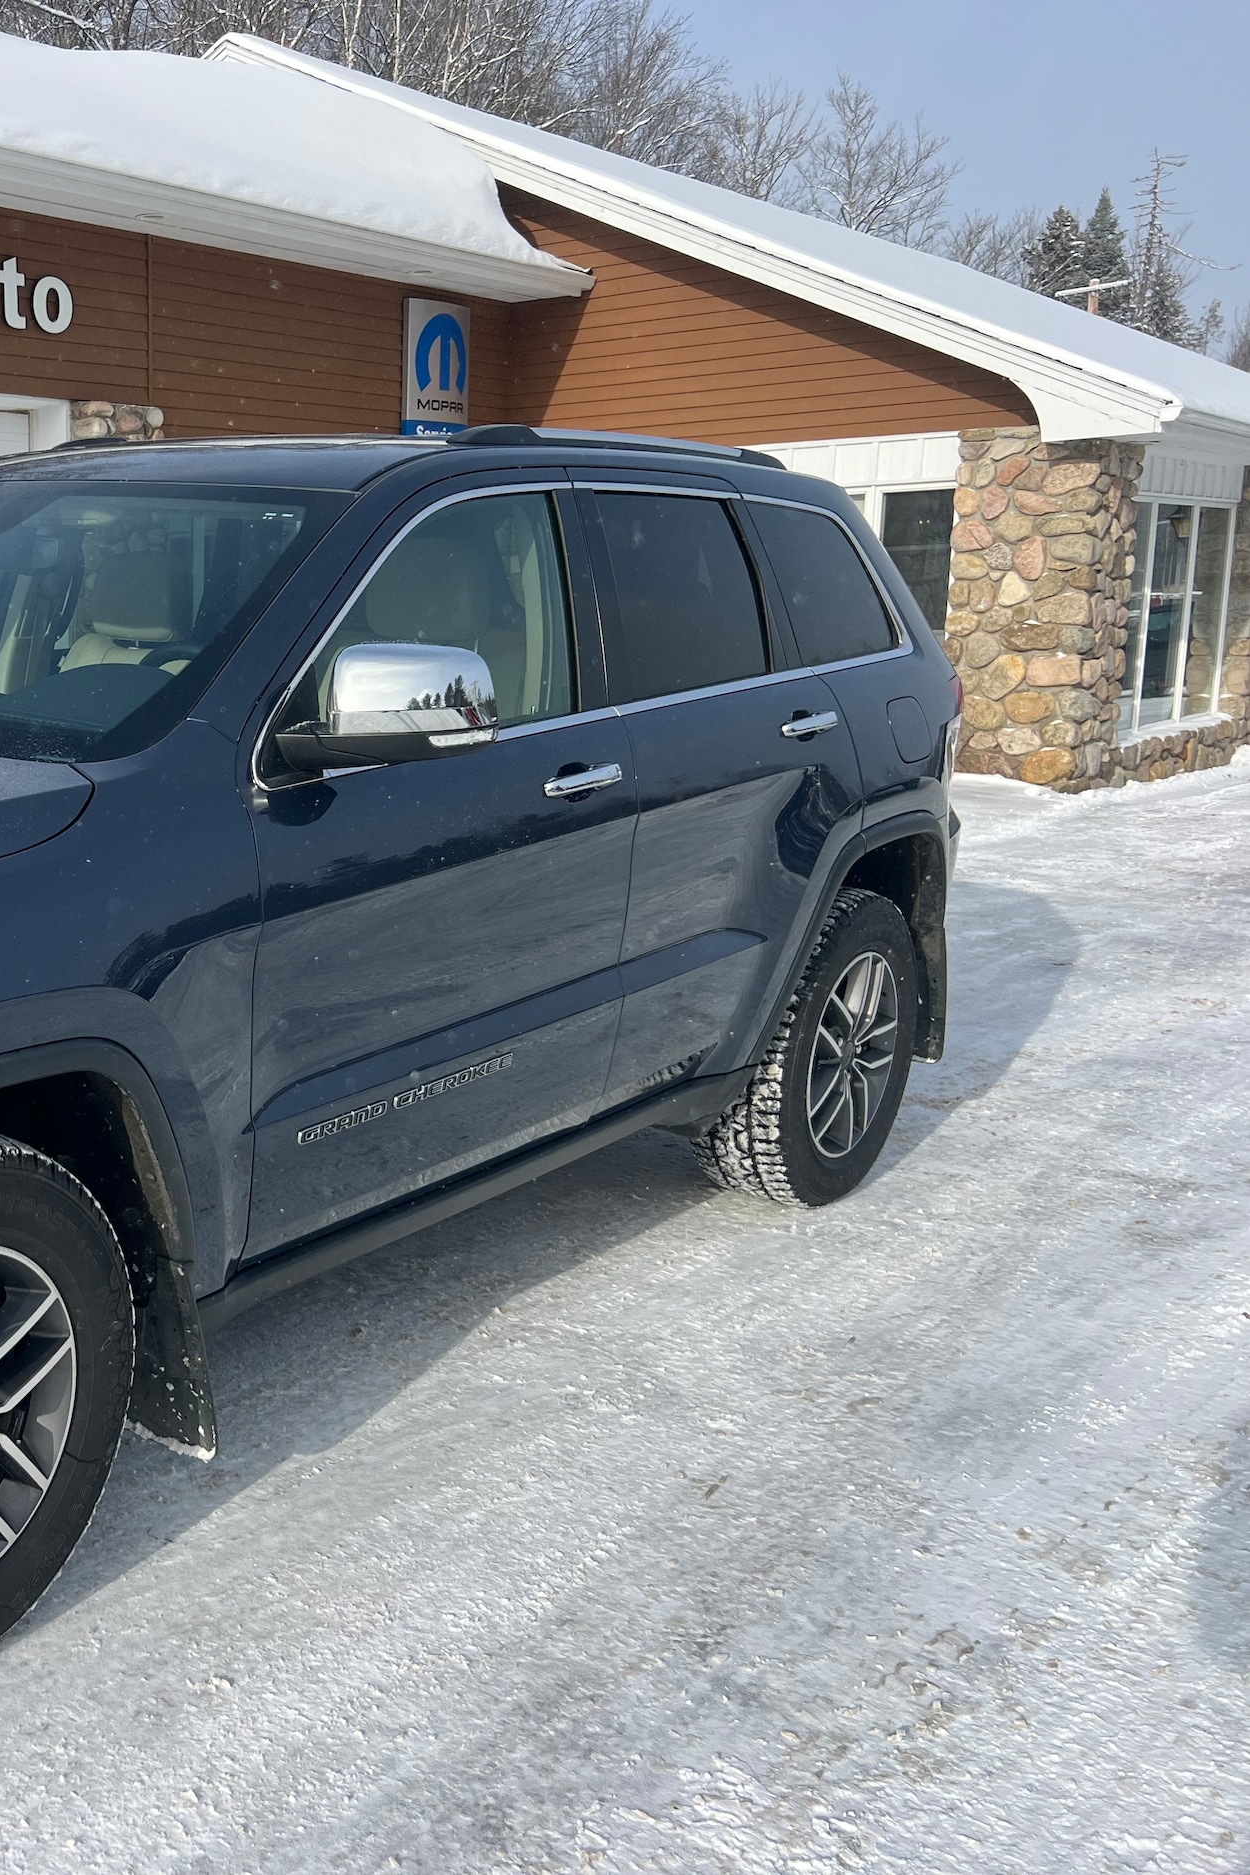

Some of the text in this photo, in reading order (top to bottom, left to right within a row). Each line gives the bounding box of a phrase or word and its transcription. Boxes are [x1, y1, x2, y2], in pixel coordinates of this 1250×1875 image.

[417, 398, 464, 414] MOPAR
[297, 1052, 514, 1145] GRAND CHEROKEE
